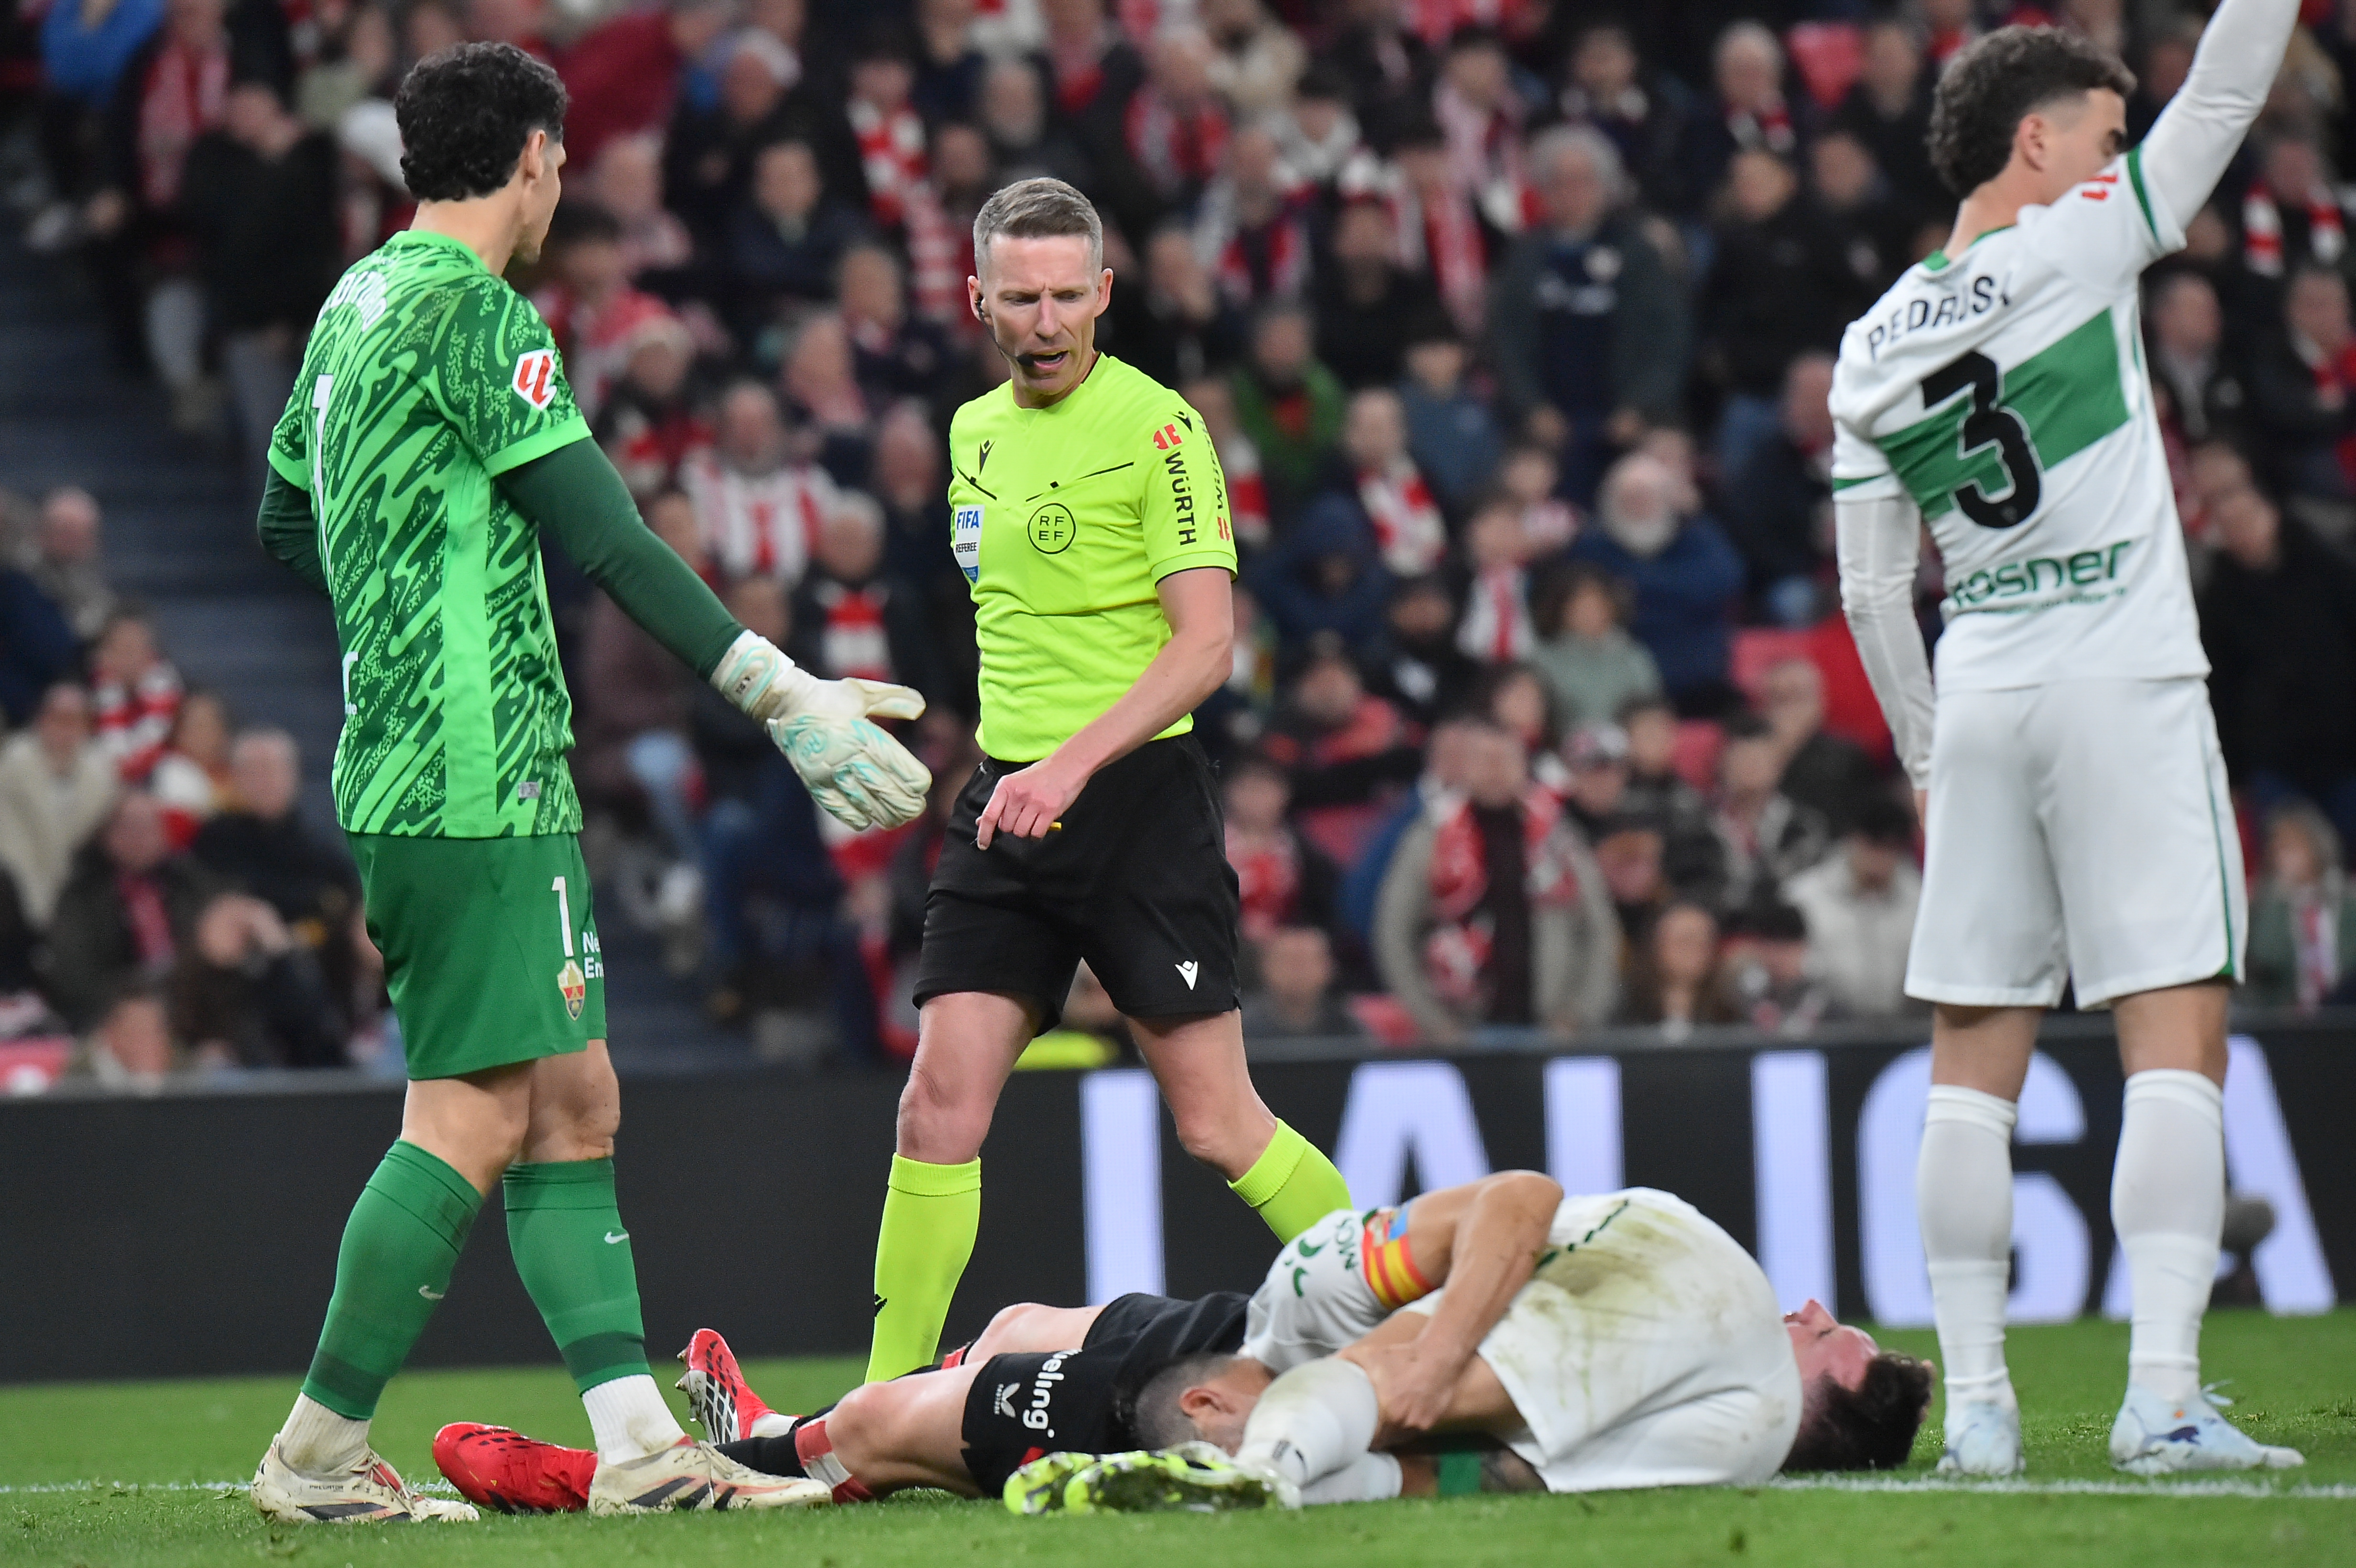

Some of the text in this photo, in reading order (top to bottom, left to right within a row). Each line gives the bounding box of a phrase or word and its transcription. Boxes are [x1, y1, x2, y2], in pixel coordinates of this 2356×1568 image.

[1868, 272, 2012, 363] PEDRS
[312, 374, 333, 575] 1
[1921, 350, 2041, 529] 3
[957, 511, 979, 530] FIFA
[1165, 451, 1197, 546] WÜRTH
[956, 542, 977, 553] REFEREE
[552, 876, 574, 958] 1
[1023, 1349, 1083, 1430] ueling
